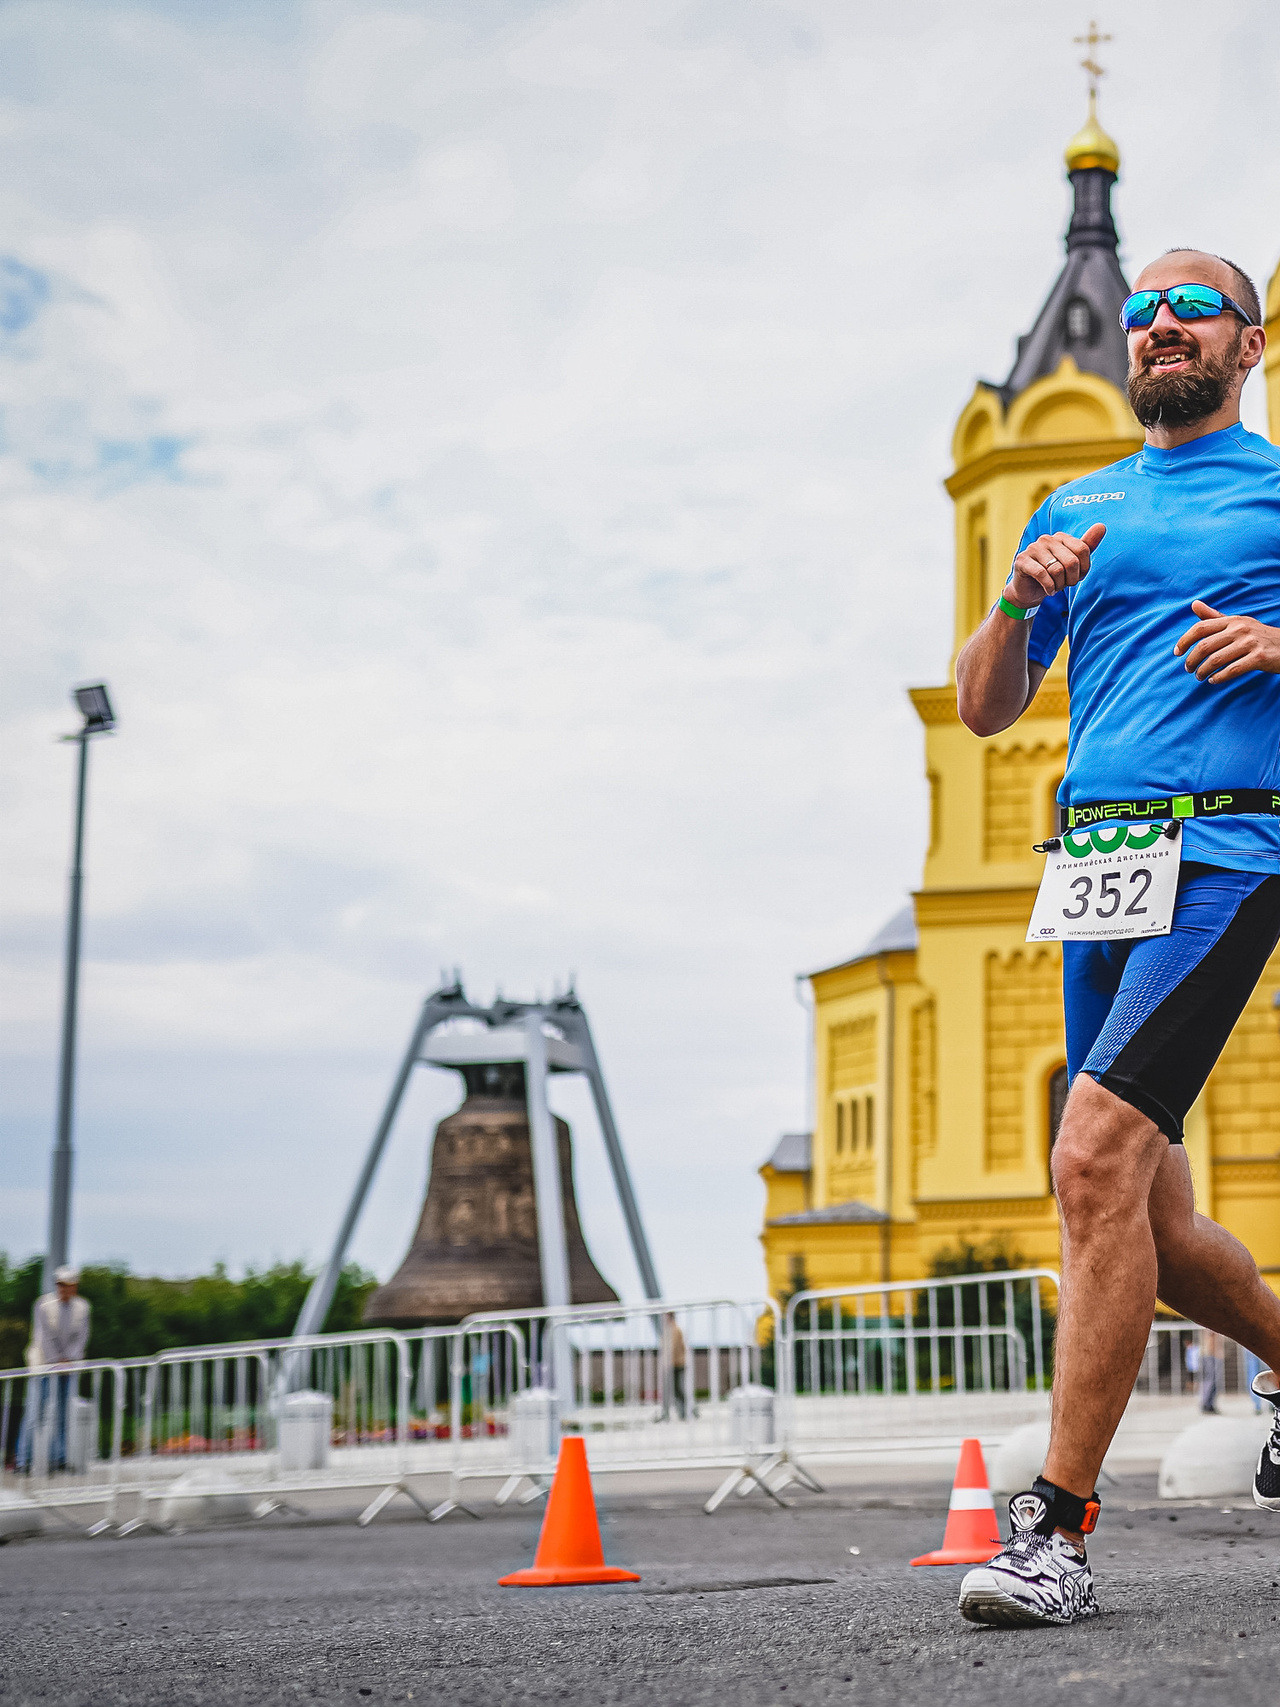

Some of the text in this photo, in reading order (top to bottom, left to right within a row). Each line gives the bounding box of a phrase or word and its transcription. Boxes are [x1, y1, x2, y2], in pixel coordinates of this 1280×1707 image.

[1056, 850, 1169, 870] ОЛИМПИЙСКАЯ ДИСТАНЦИЯ
[1062, 868, 1153, 919] 352
